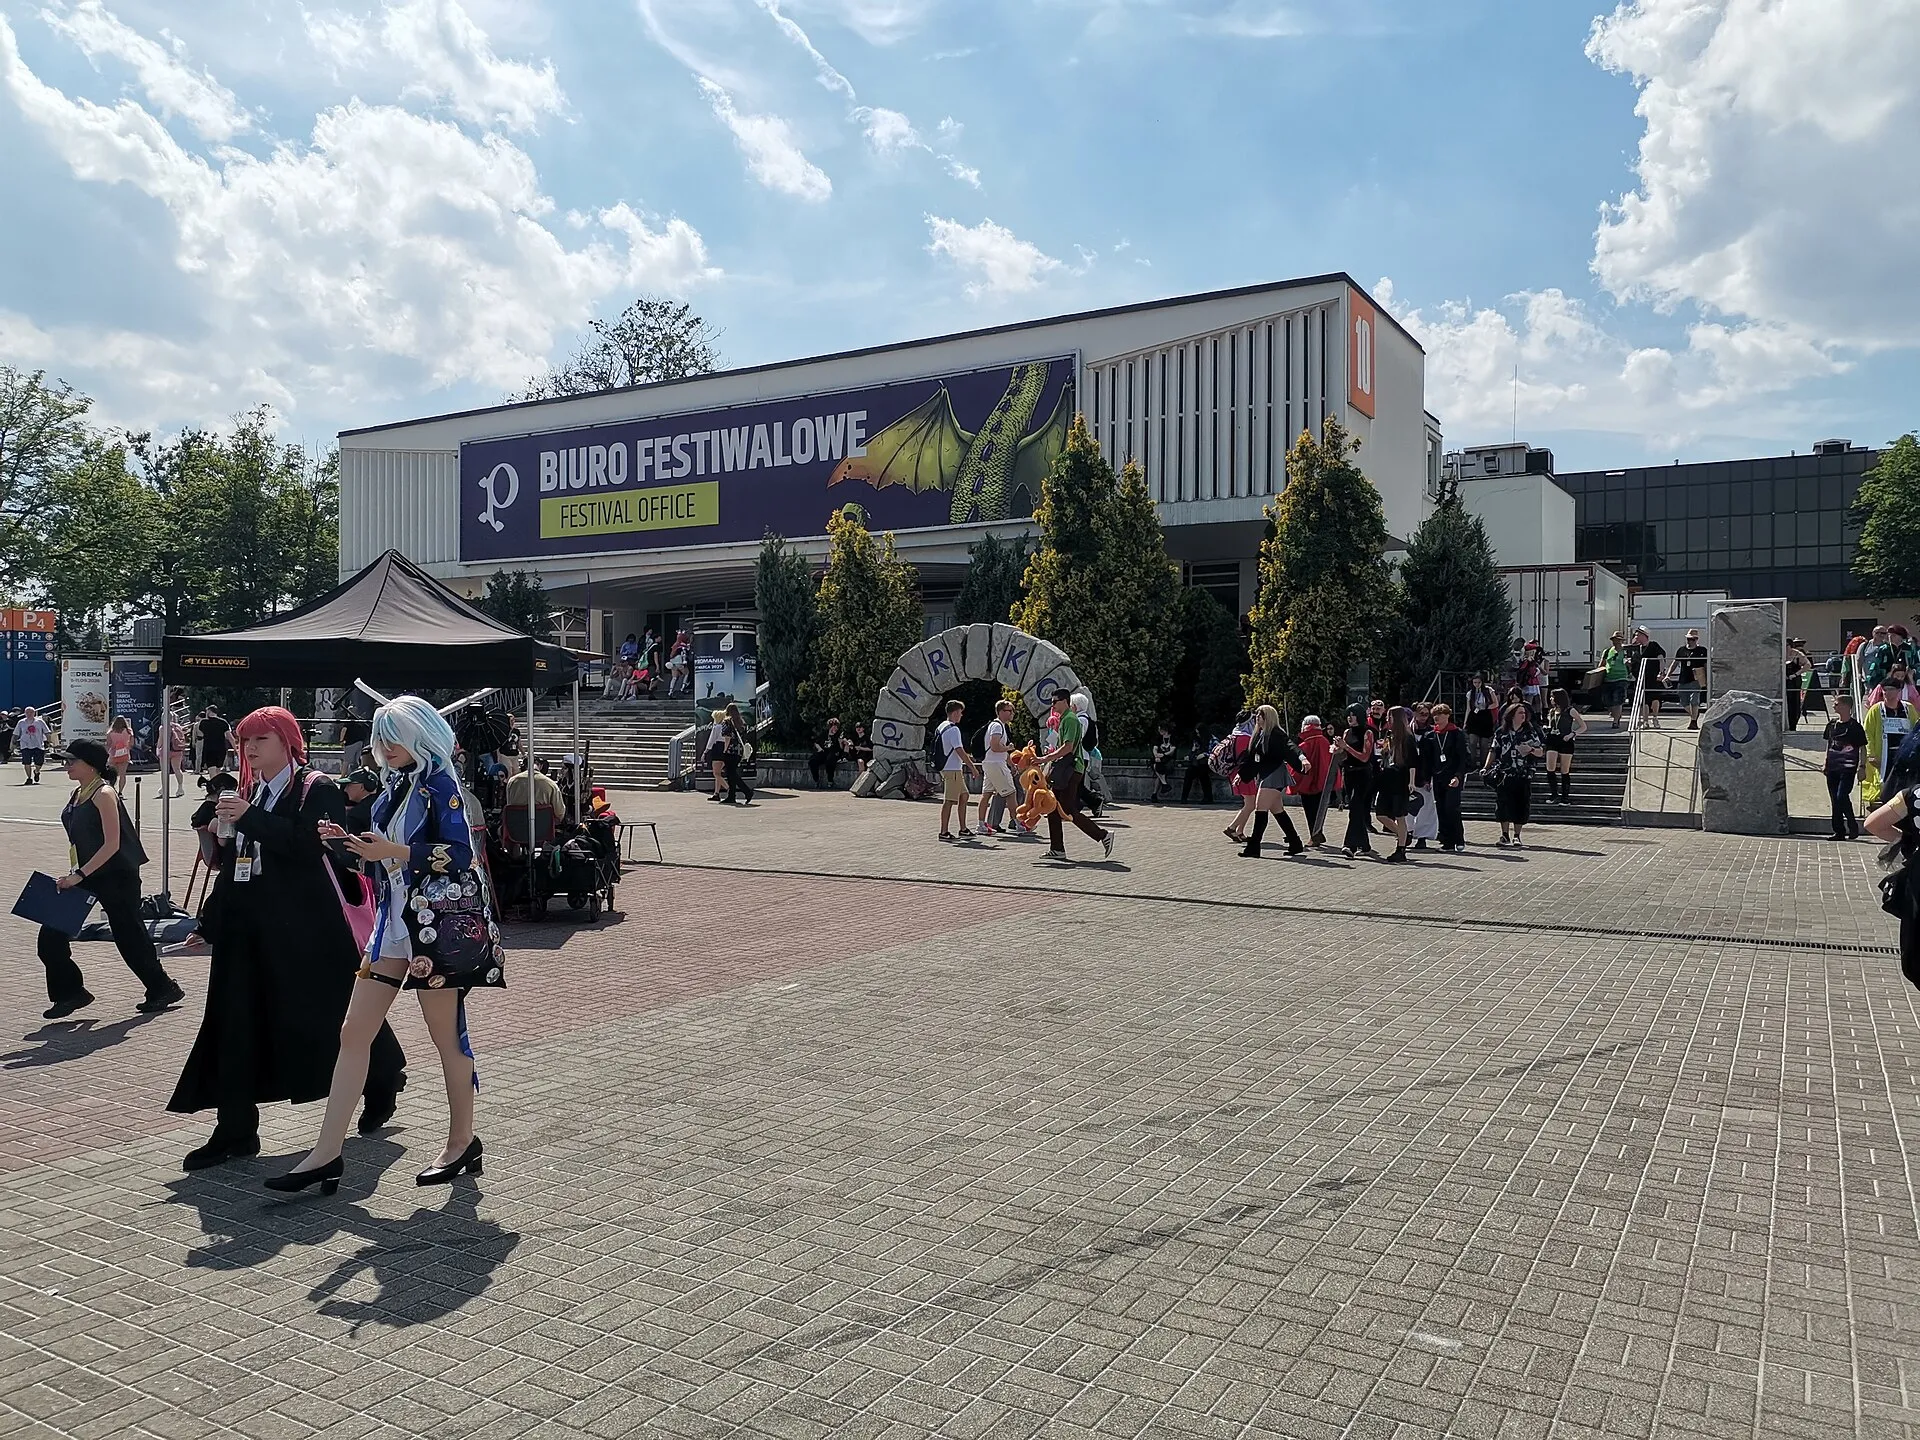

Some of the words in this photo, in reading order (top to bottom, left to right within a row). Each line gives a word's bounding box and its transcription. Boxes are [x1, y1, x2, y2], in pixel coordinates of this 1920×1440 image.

[1355, 315, 1371, 395] 10
[540, 442, 628, 492] BIURO
[637, 410, 868, 482] FESTIWALOWE
[560, 500, 633, 529] FESTIVAL
[638, 492, 696, 523] OFFICE
[23, 611, 46, 629] P4
[195, 657, 247, 666] YELLOWÓZ
